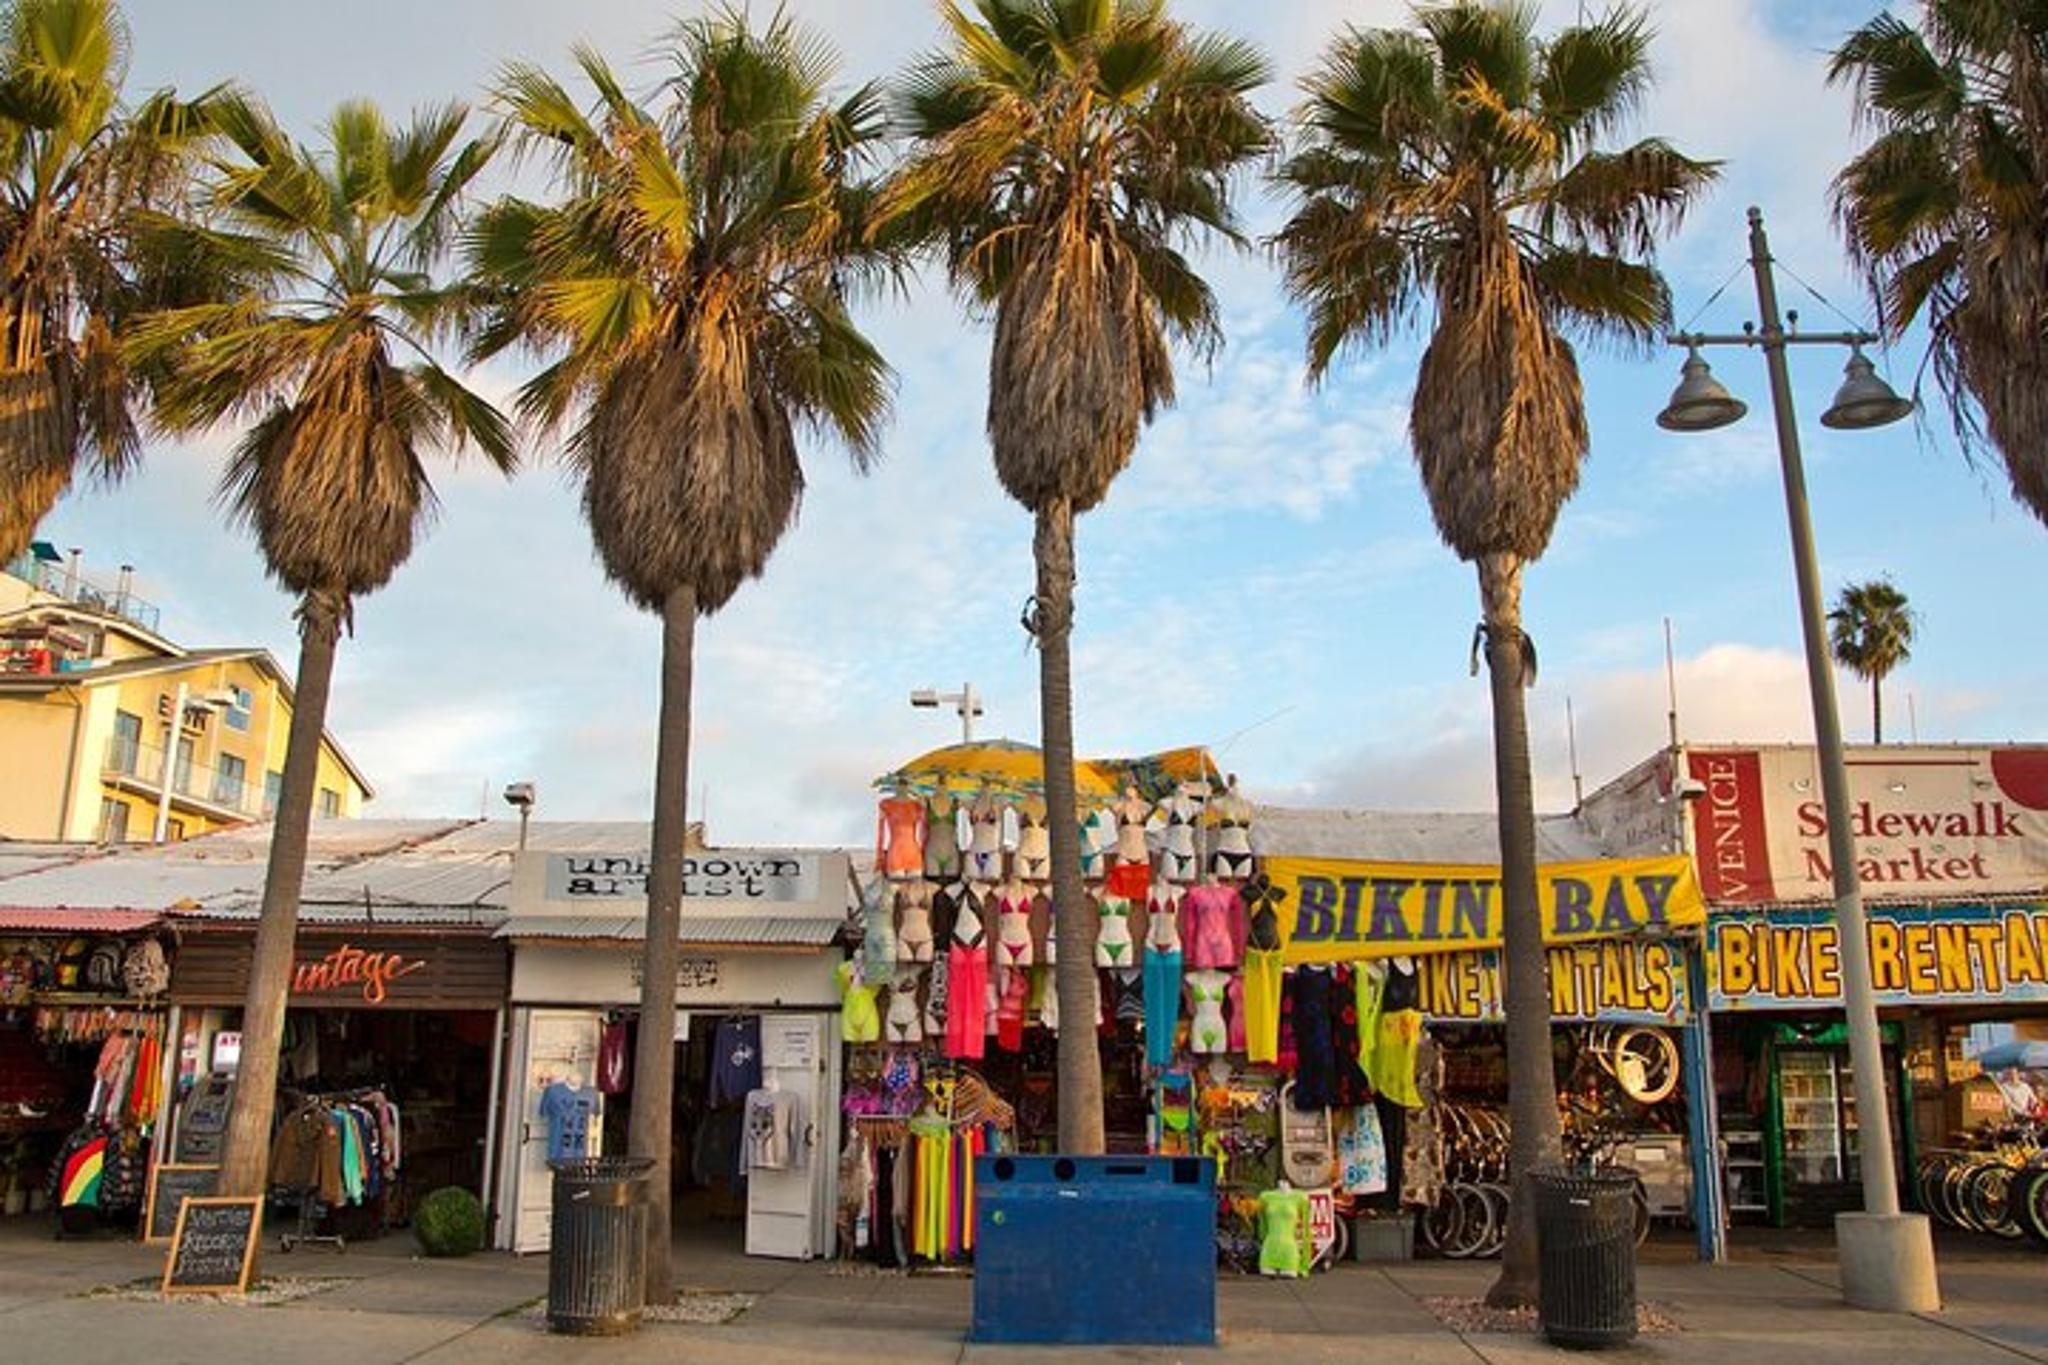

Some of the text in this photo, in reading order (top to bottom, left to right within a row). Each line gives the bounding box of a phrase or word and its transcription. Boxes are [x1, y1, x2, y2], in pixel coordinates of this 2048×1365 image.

[1708, 757, 1749, 899] VENICE
[1797, 801, 2024, 838] Sdewalk
[1289, 874, 1680, 943] BIKIN BAY
[1417, 939, 1673, 1018] IKE NTALS
[1718, 922, 1843, 998] BIKE
